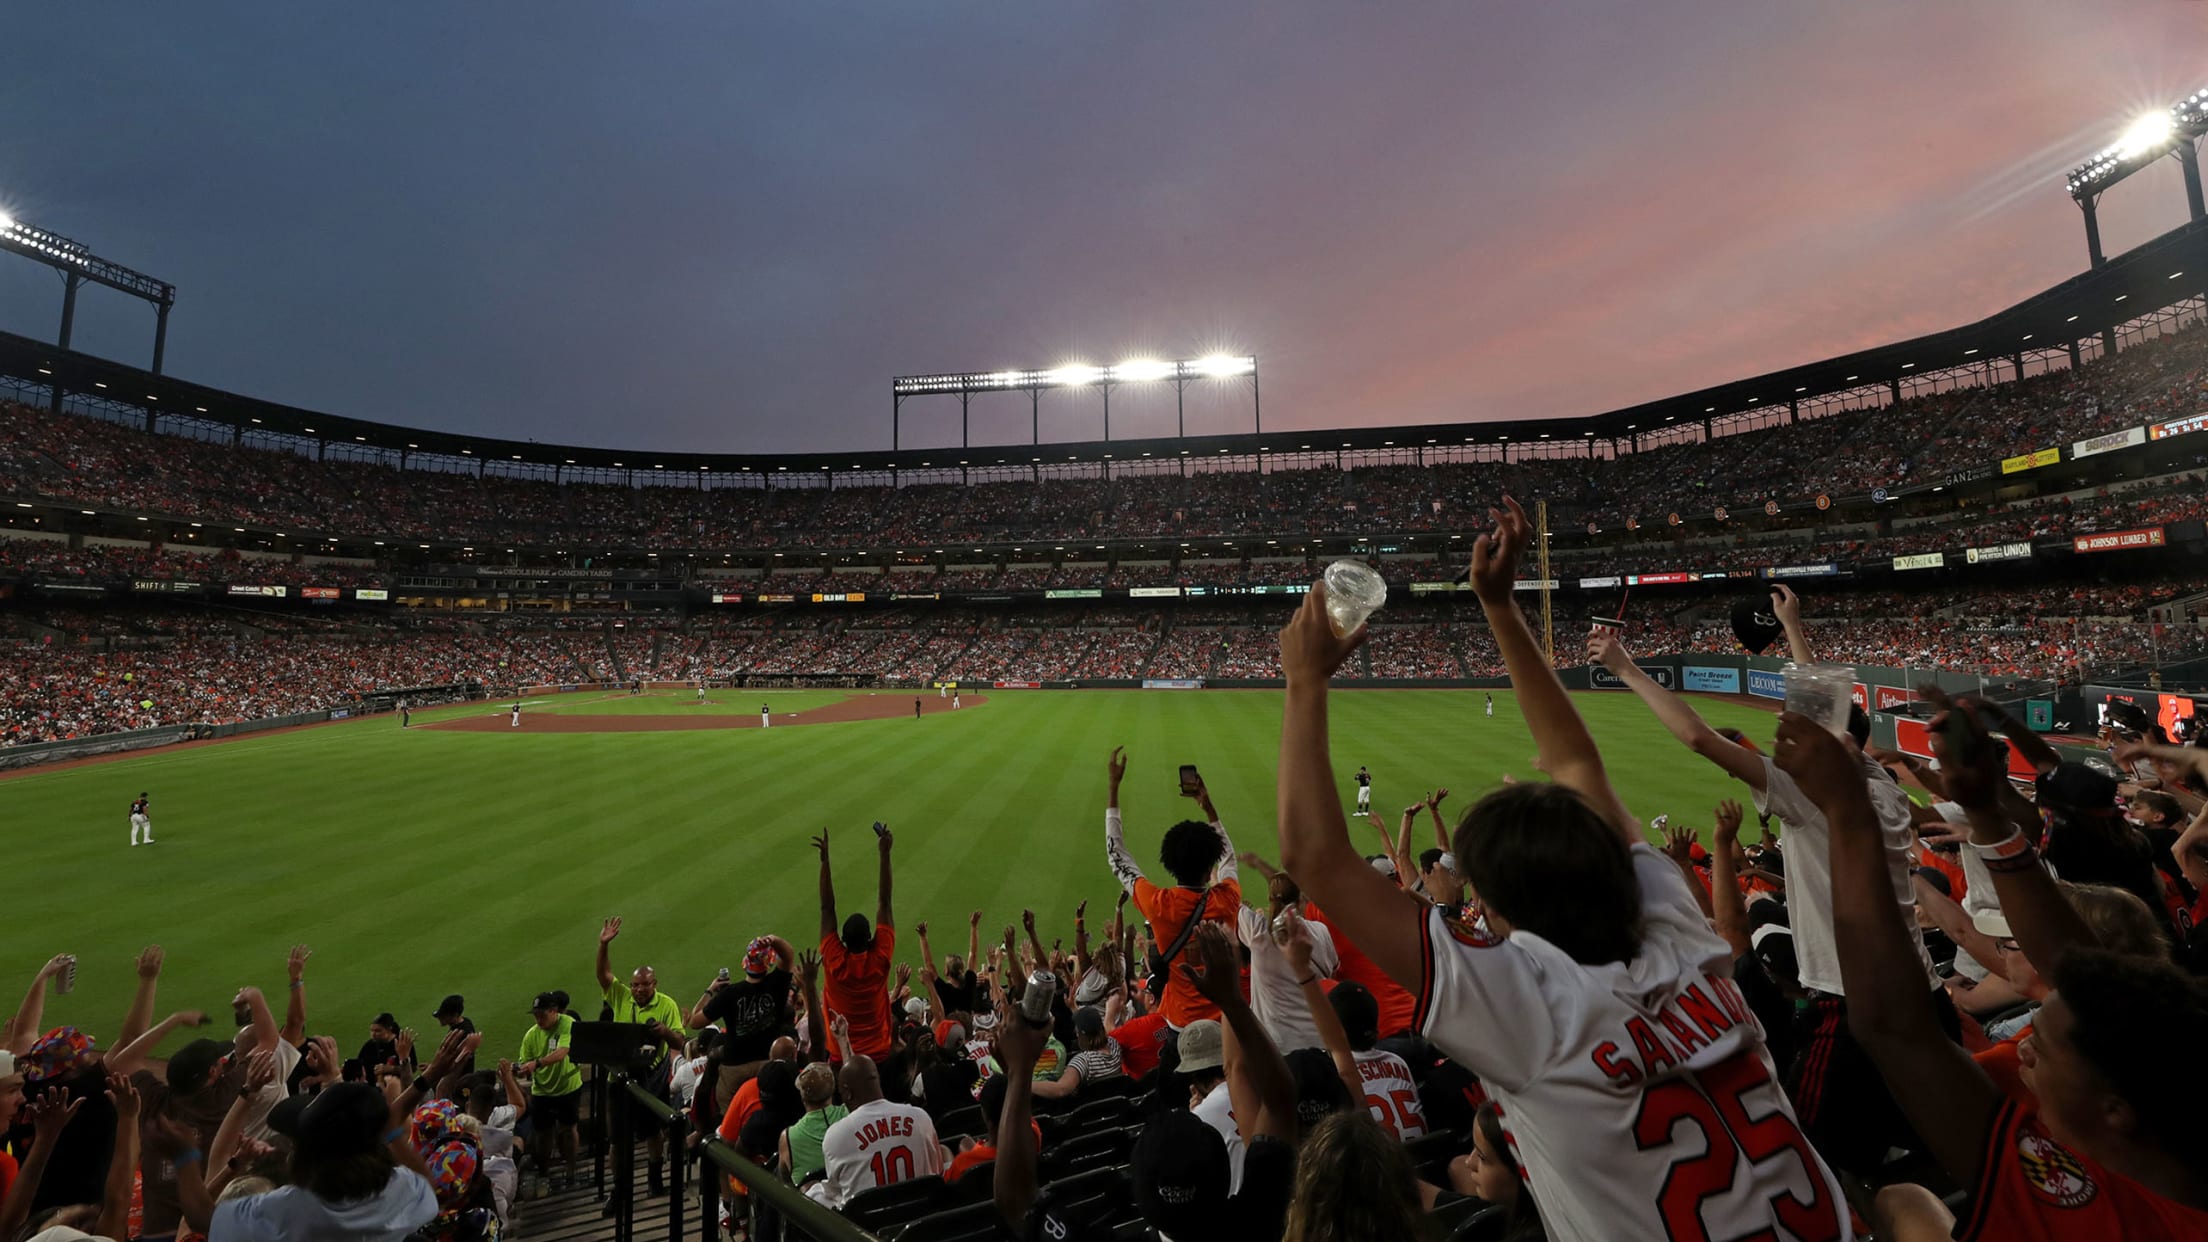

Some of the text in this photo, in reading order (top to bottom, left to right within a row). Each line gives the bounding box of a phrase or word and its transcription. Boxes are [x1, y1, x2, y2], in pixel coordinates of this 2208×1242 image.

[1945, 470, 1973, 486] GANZ
[1875, 491, 1885, 499] 42
[1767, 504, 1776, 512] 33
[2090, 536, 2118, 549] JOHNSON
[2120, 533, 2147, 546] LUMBER
[2003, 542, 2031, 557] UNION
[135, 582, 159, 590] SHIFT
[1708, 671, 1732, 680] Breeze
[1750, 677, 1776, 693] LECOM
[854, 1115, 914, 1151] JONES
[1633, 1052, 1842, 1242] 25
[870, 1144, 915, 1187] 10
